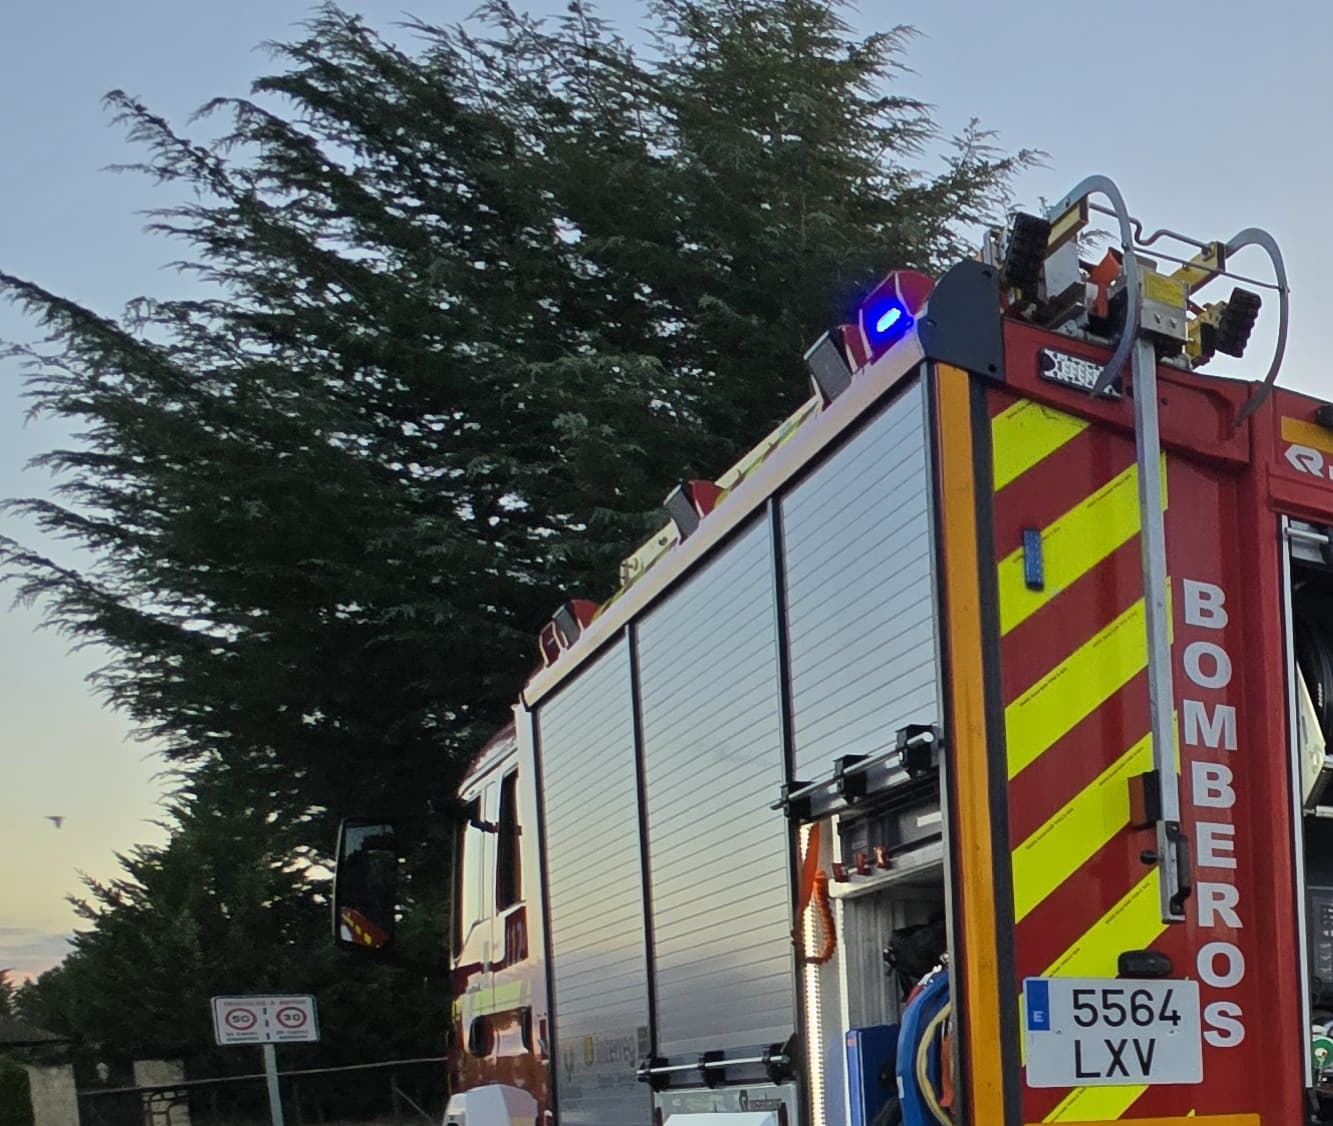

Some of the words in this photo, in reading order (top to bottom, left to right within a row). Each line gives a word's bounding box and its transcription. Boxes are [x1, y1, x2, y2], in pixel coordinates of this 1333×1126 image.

[1182, 578, 1246, 1048] BOMBEROS
[232, 1015, 250, 1023] 50
[283, 1013, 301, 1021] 30
[1033, 1011, 1044, 1022] E
[1072, 988, 1182, 1028] 5564
[1074, 1038, 1156, 1079] LXV
